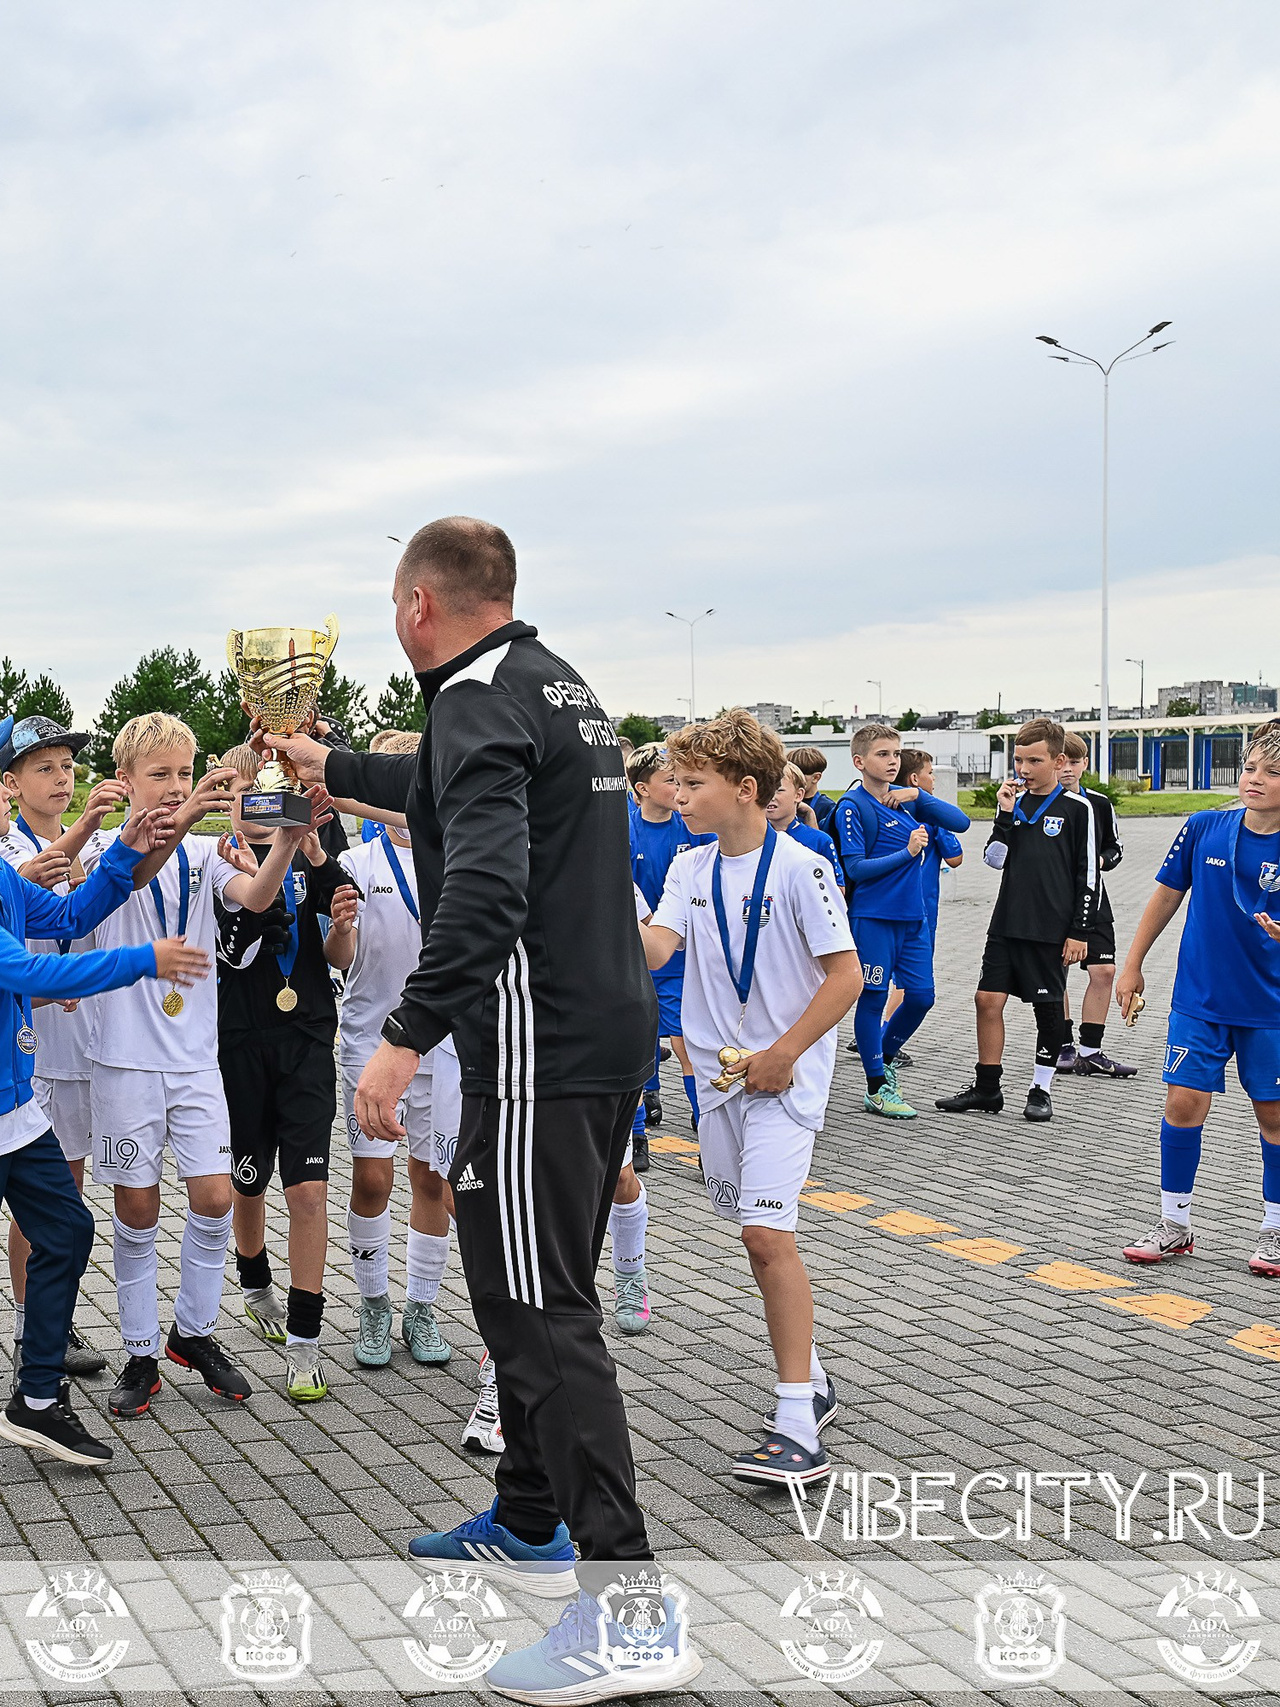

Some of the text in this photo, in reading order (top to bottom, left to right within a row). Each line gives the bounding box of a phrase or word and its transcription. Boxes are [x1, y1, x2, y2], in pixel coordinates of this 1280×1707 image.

[1205, 856, 1226, 867] JAKO
[372, 885, 393, 894] JAKO
[863, 963, 884, 986] 18
[1161, 1044, 1189, 1074] 17
[99, 1135, 140, 1171] 19
[305, 1156, 324, 1165] JAKO
[456, 1179, 484, 1191] adidas
[754, 1198, 783, 1210] JAKO
[617, 1253, 643, 1263] JAKO
